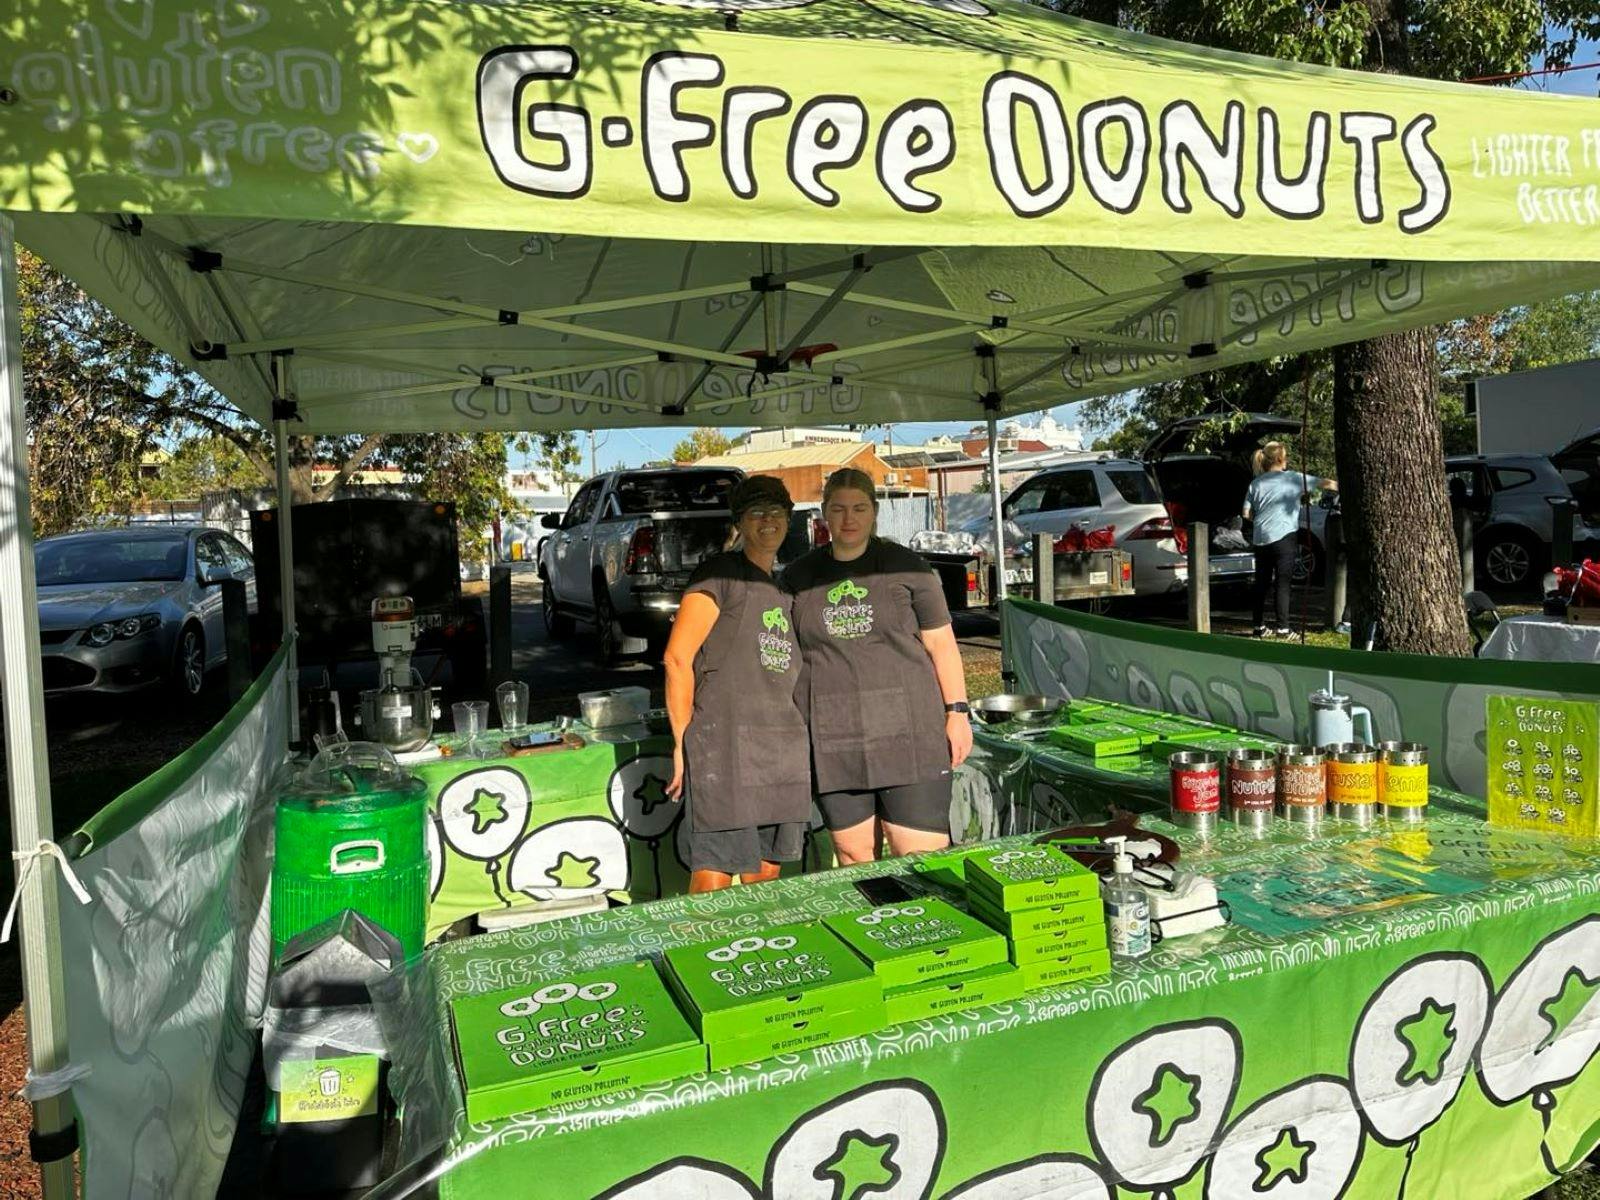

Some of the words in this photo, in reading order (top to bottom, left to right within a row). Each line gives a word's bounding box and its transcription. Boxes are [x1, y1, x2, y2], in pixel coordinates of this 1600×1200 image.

[12, 14, 342, 132] gluten
[982, 70, 1451, 234] DONUTS
[1471, 132, 1573, 178] LIGHTER
[1519, 722, 1564, 734] DONUTS
[728, 967, 831, 997] DONUTS
[510, 1026, 647, 1067] DONUTS
[813, 1037, 875, 1068] FRESHER
[551, 1090, 562, 1100] NO
[563, 1083, 593, 1097] GLUTEN
